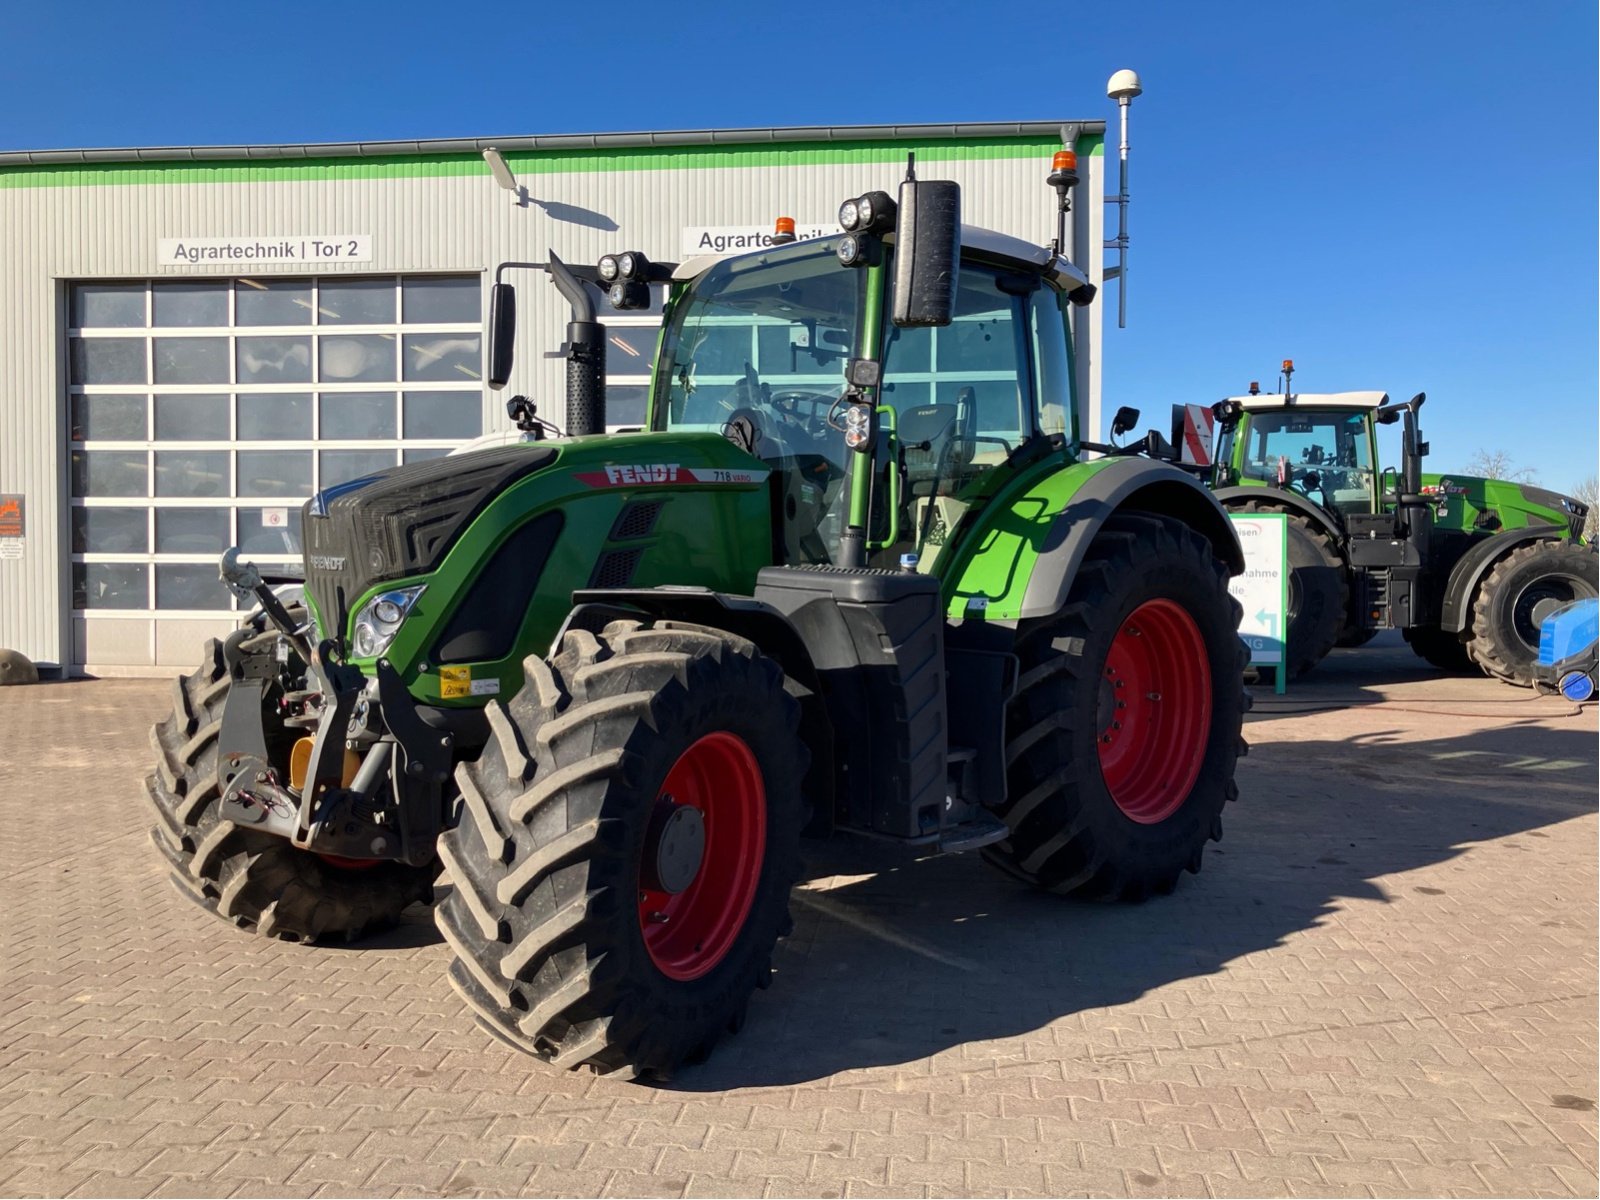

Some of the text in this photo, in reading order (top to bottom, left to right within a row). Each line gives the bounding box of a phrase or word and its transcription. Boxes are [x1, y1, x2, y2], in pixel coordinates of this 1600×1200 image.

[174, 242, 295, 263] Agrartechnik
[312, 241, 342, 257] Tor
[348, 241, 358, 256] 2
[604, 463, 751, 485] FENDT 718 VARIO
[1243, 569, 1278, 578] nahme
